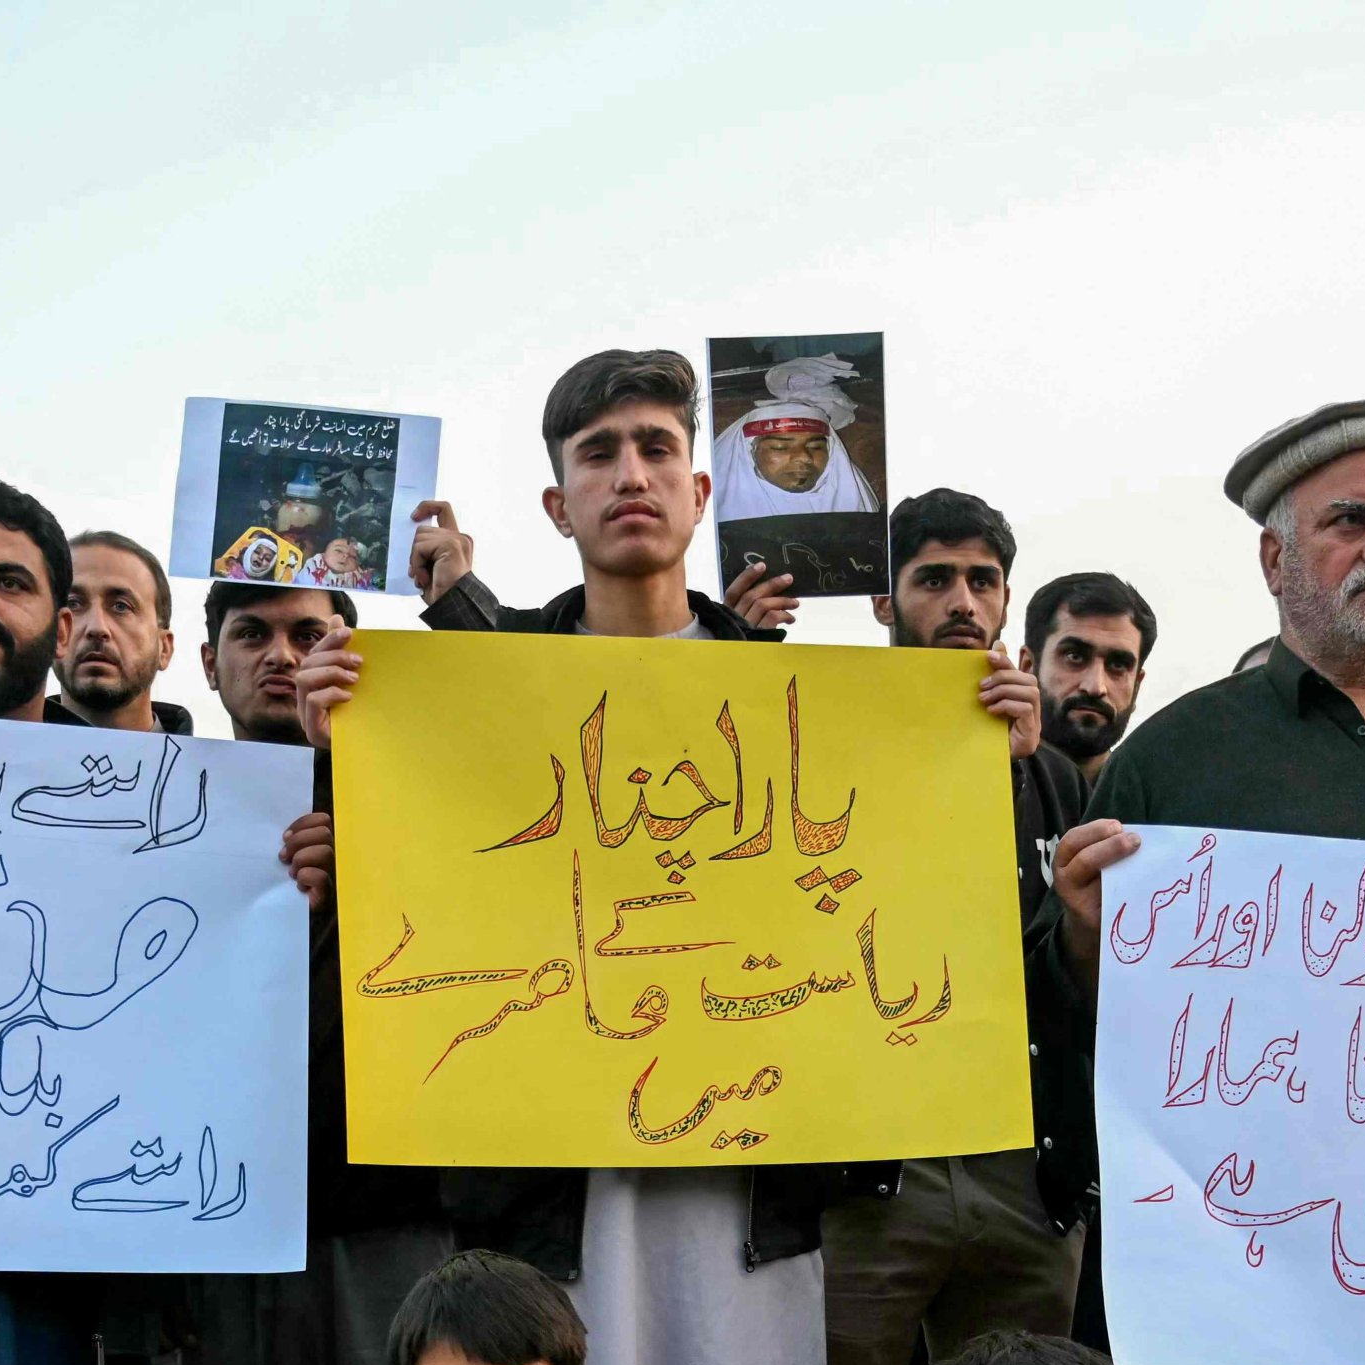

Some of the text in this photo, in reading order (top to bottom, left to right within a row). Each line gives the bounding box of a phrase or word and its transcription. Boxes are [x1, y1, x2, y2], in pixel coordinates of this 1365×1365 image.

[321, 419, 347, 433] انسانیت
[347, 424, 366, 436] میں
[366, 421, 381, 440] کرم
[381, 418, 395, 438] ضلع
[270, 437, 295, 448] سوالات
[297, 433, 310, 450] گئے
[309, 442, 332, 454] مارے
[331, 440, 351, 456] مسافر
[352, 441, 365, 456] گئے
[377, 446, 393, 460] محافظ
[474, 673, 862, 915] پاراچنار
[356, 847, 953, 1086] ریاست کے محاصرے
[1162, 993, 1306, 1108] ہمارا
[628, 1055, 783, 1151] میں
